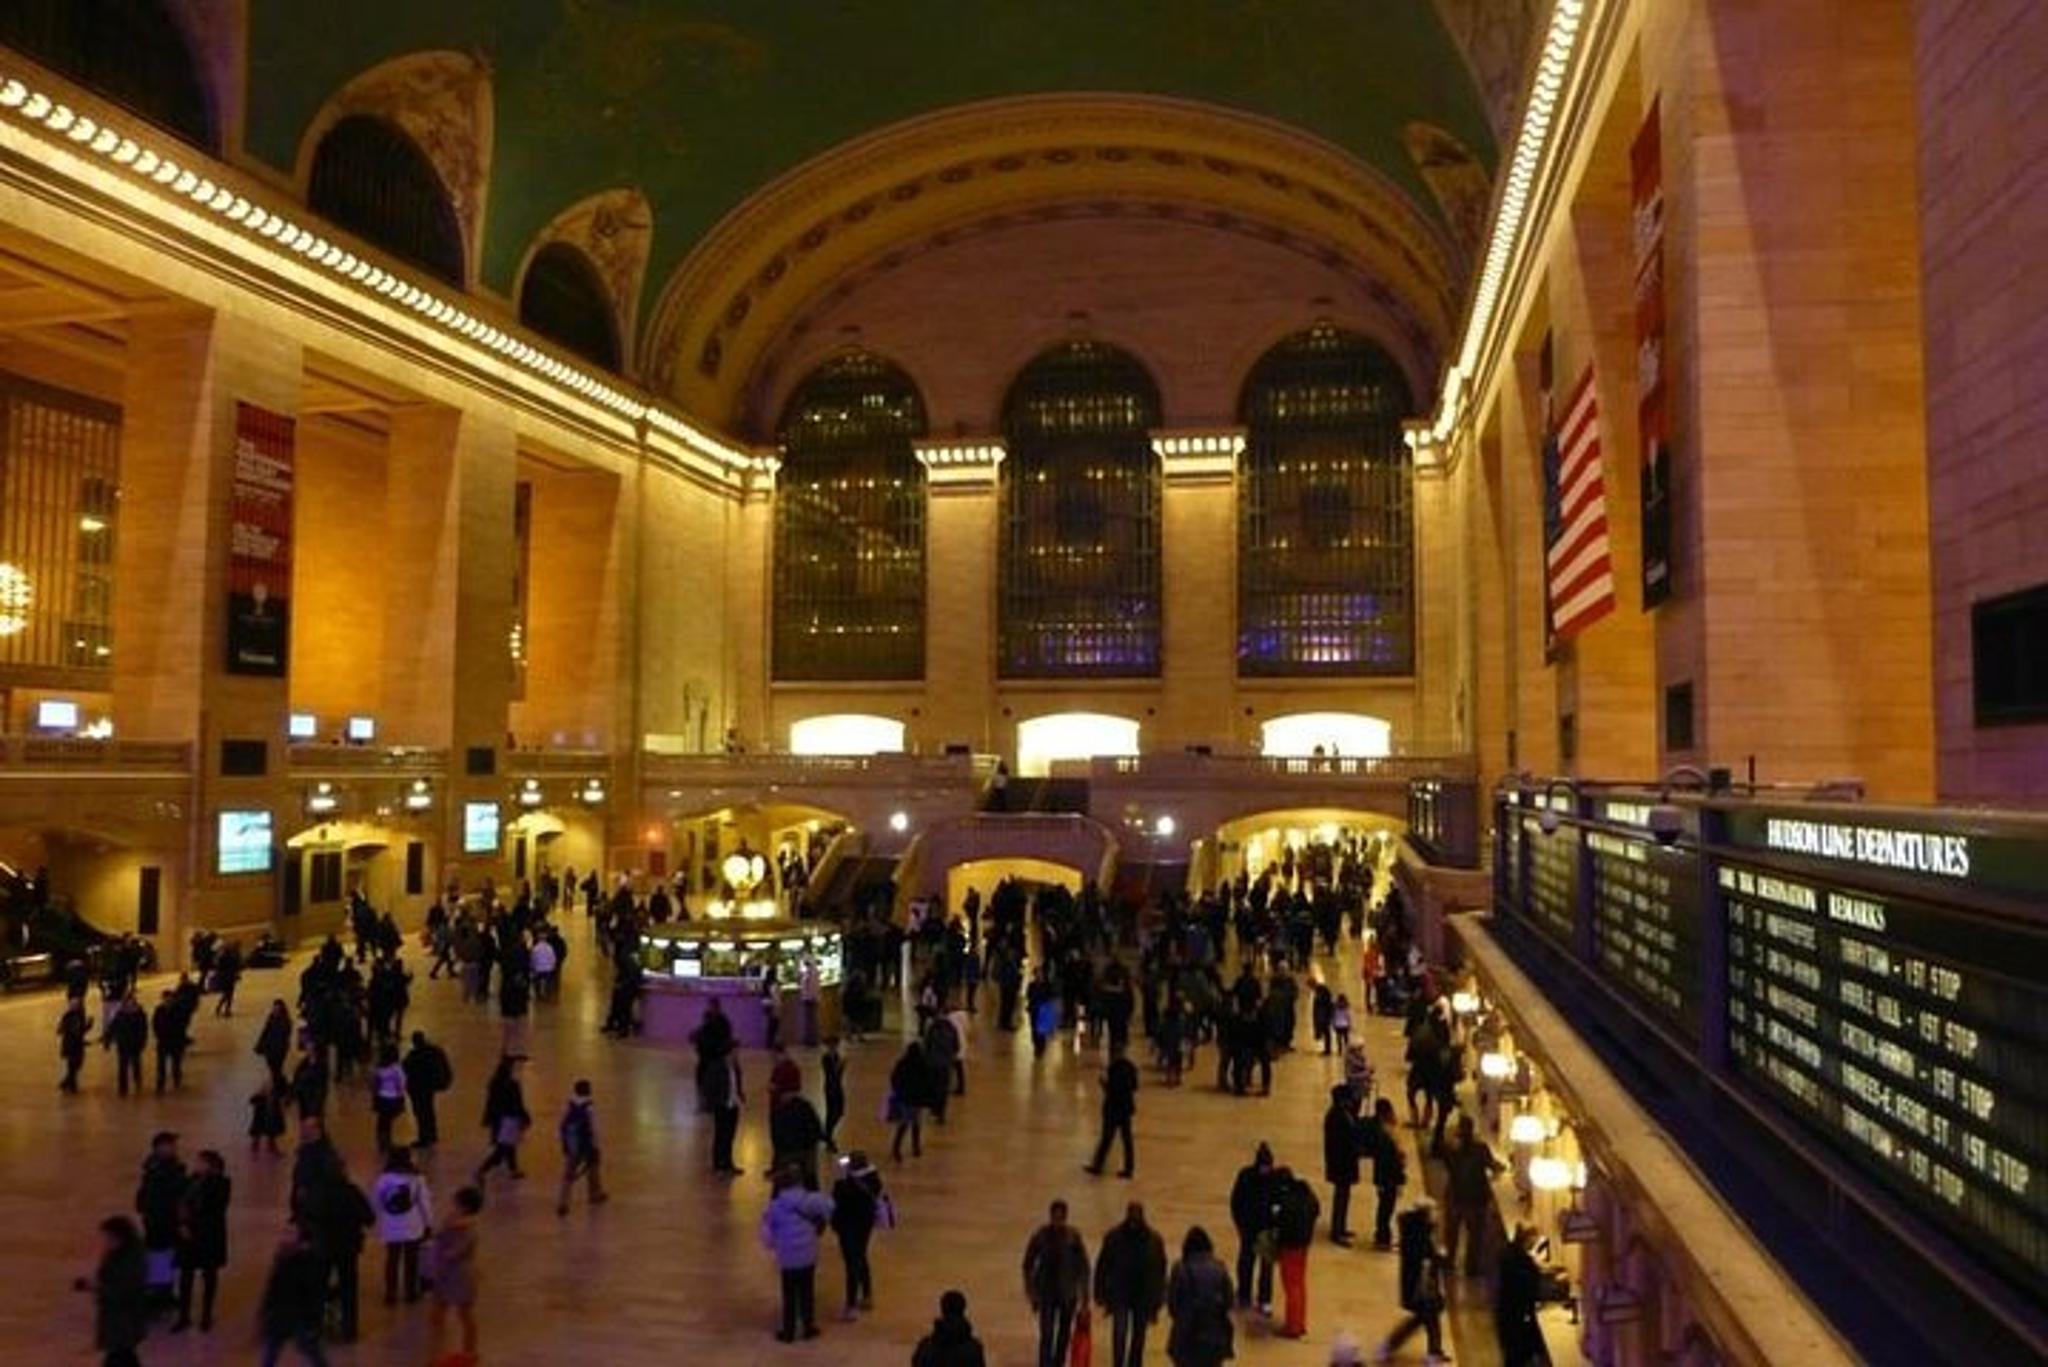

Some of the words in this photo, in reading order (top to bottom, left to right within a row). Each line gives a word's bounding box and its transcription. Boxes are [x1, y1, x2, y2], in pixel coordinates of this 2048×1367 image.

[1768, 819, 1818, 852] HUDSON
[1821, 823, 1855, 859] LINE
[1856, 827, 1969, 877] DEPARTURES
[1993, 1149, 2029, 1194] STOP
